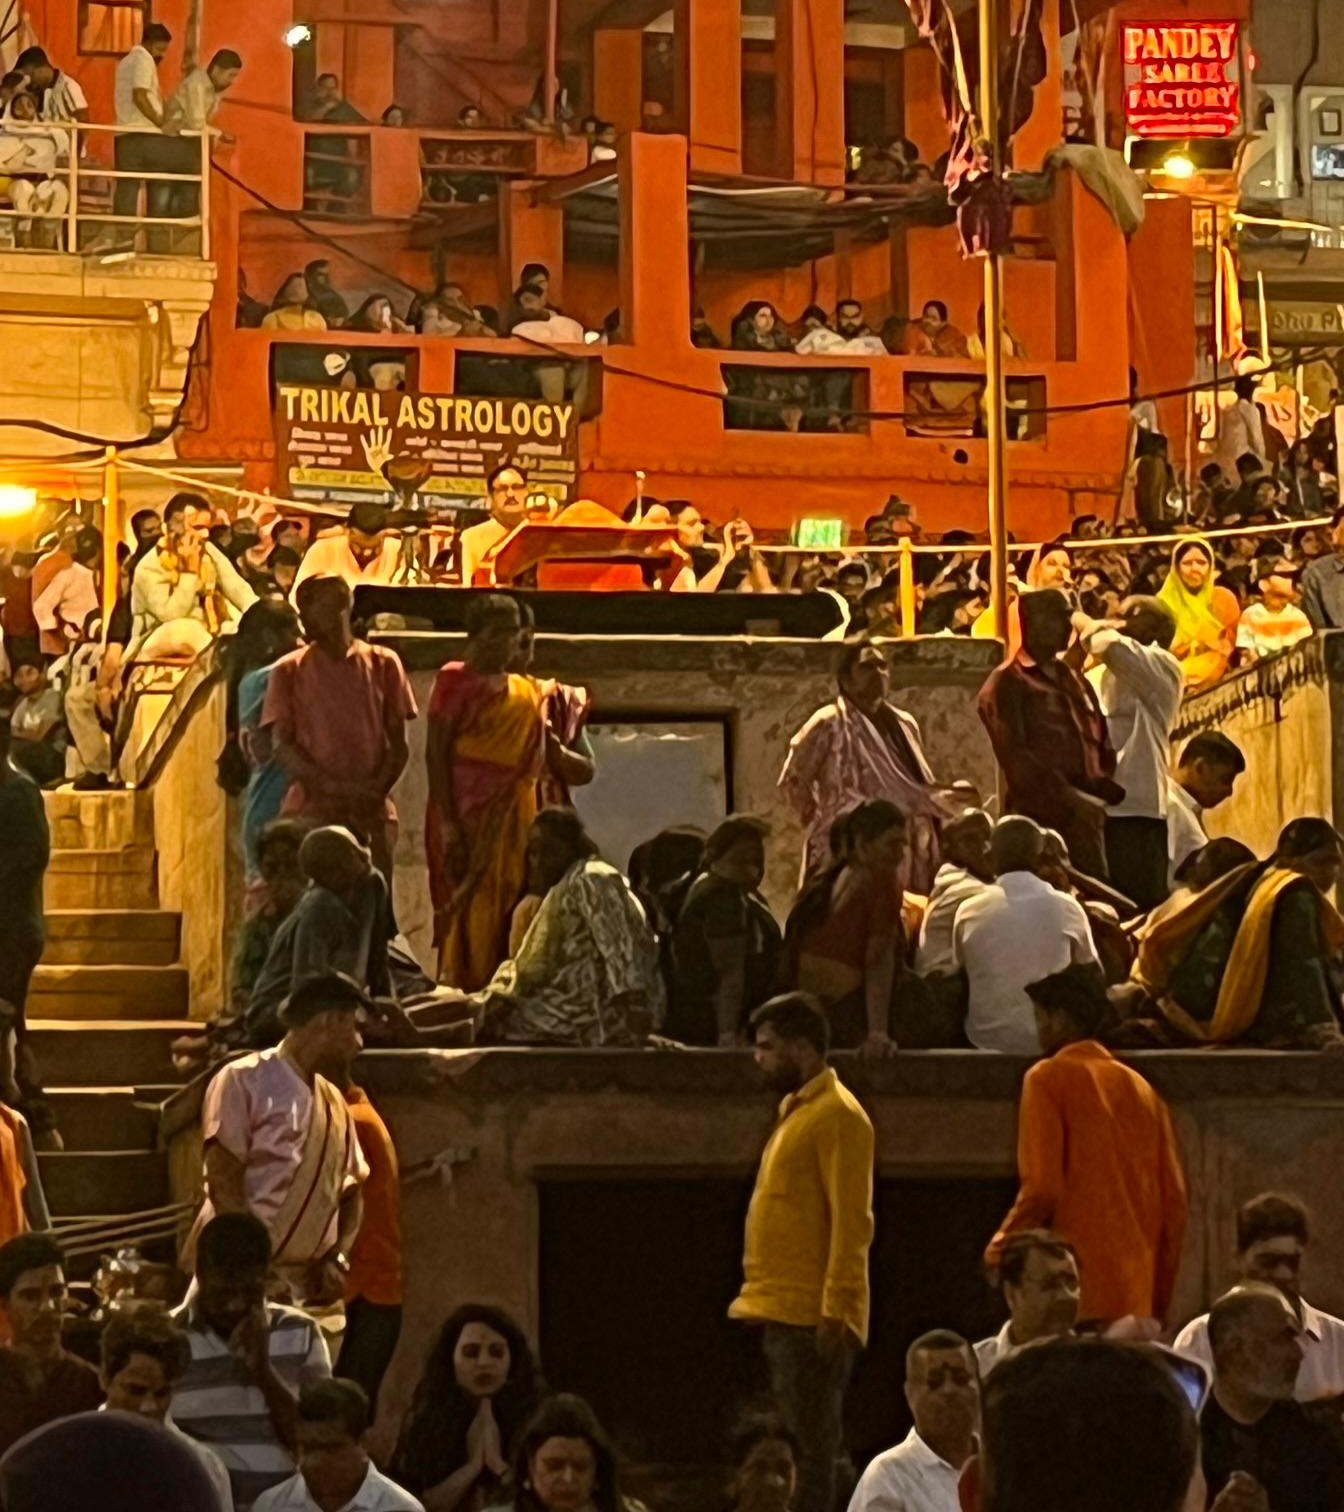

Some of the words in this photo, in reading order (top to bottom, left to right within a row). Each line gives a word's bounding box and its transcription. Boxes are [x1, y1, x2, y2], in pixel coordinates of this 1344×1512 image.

[1124, 24, 1236, 59] PANDEY
[1129, 85, 1237, 109] FACTORY
[280, 387, 388, 426] TRIKAL
[397, 395, 573, 439] ASTROLOGY
